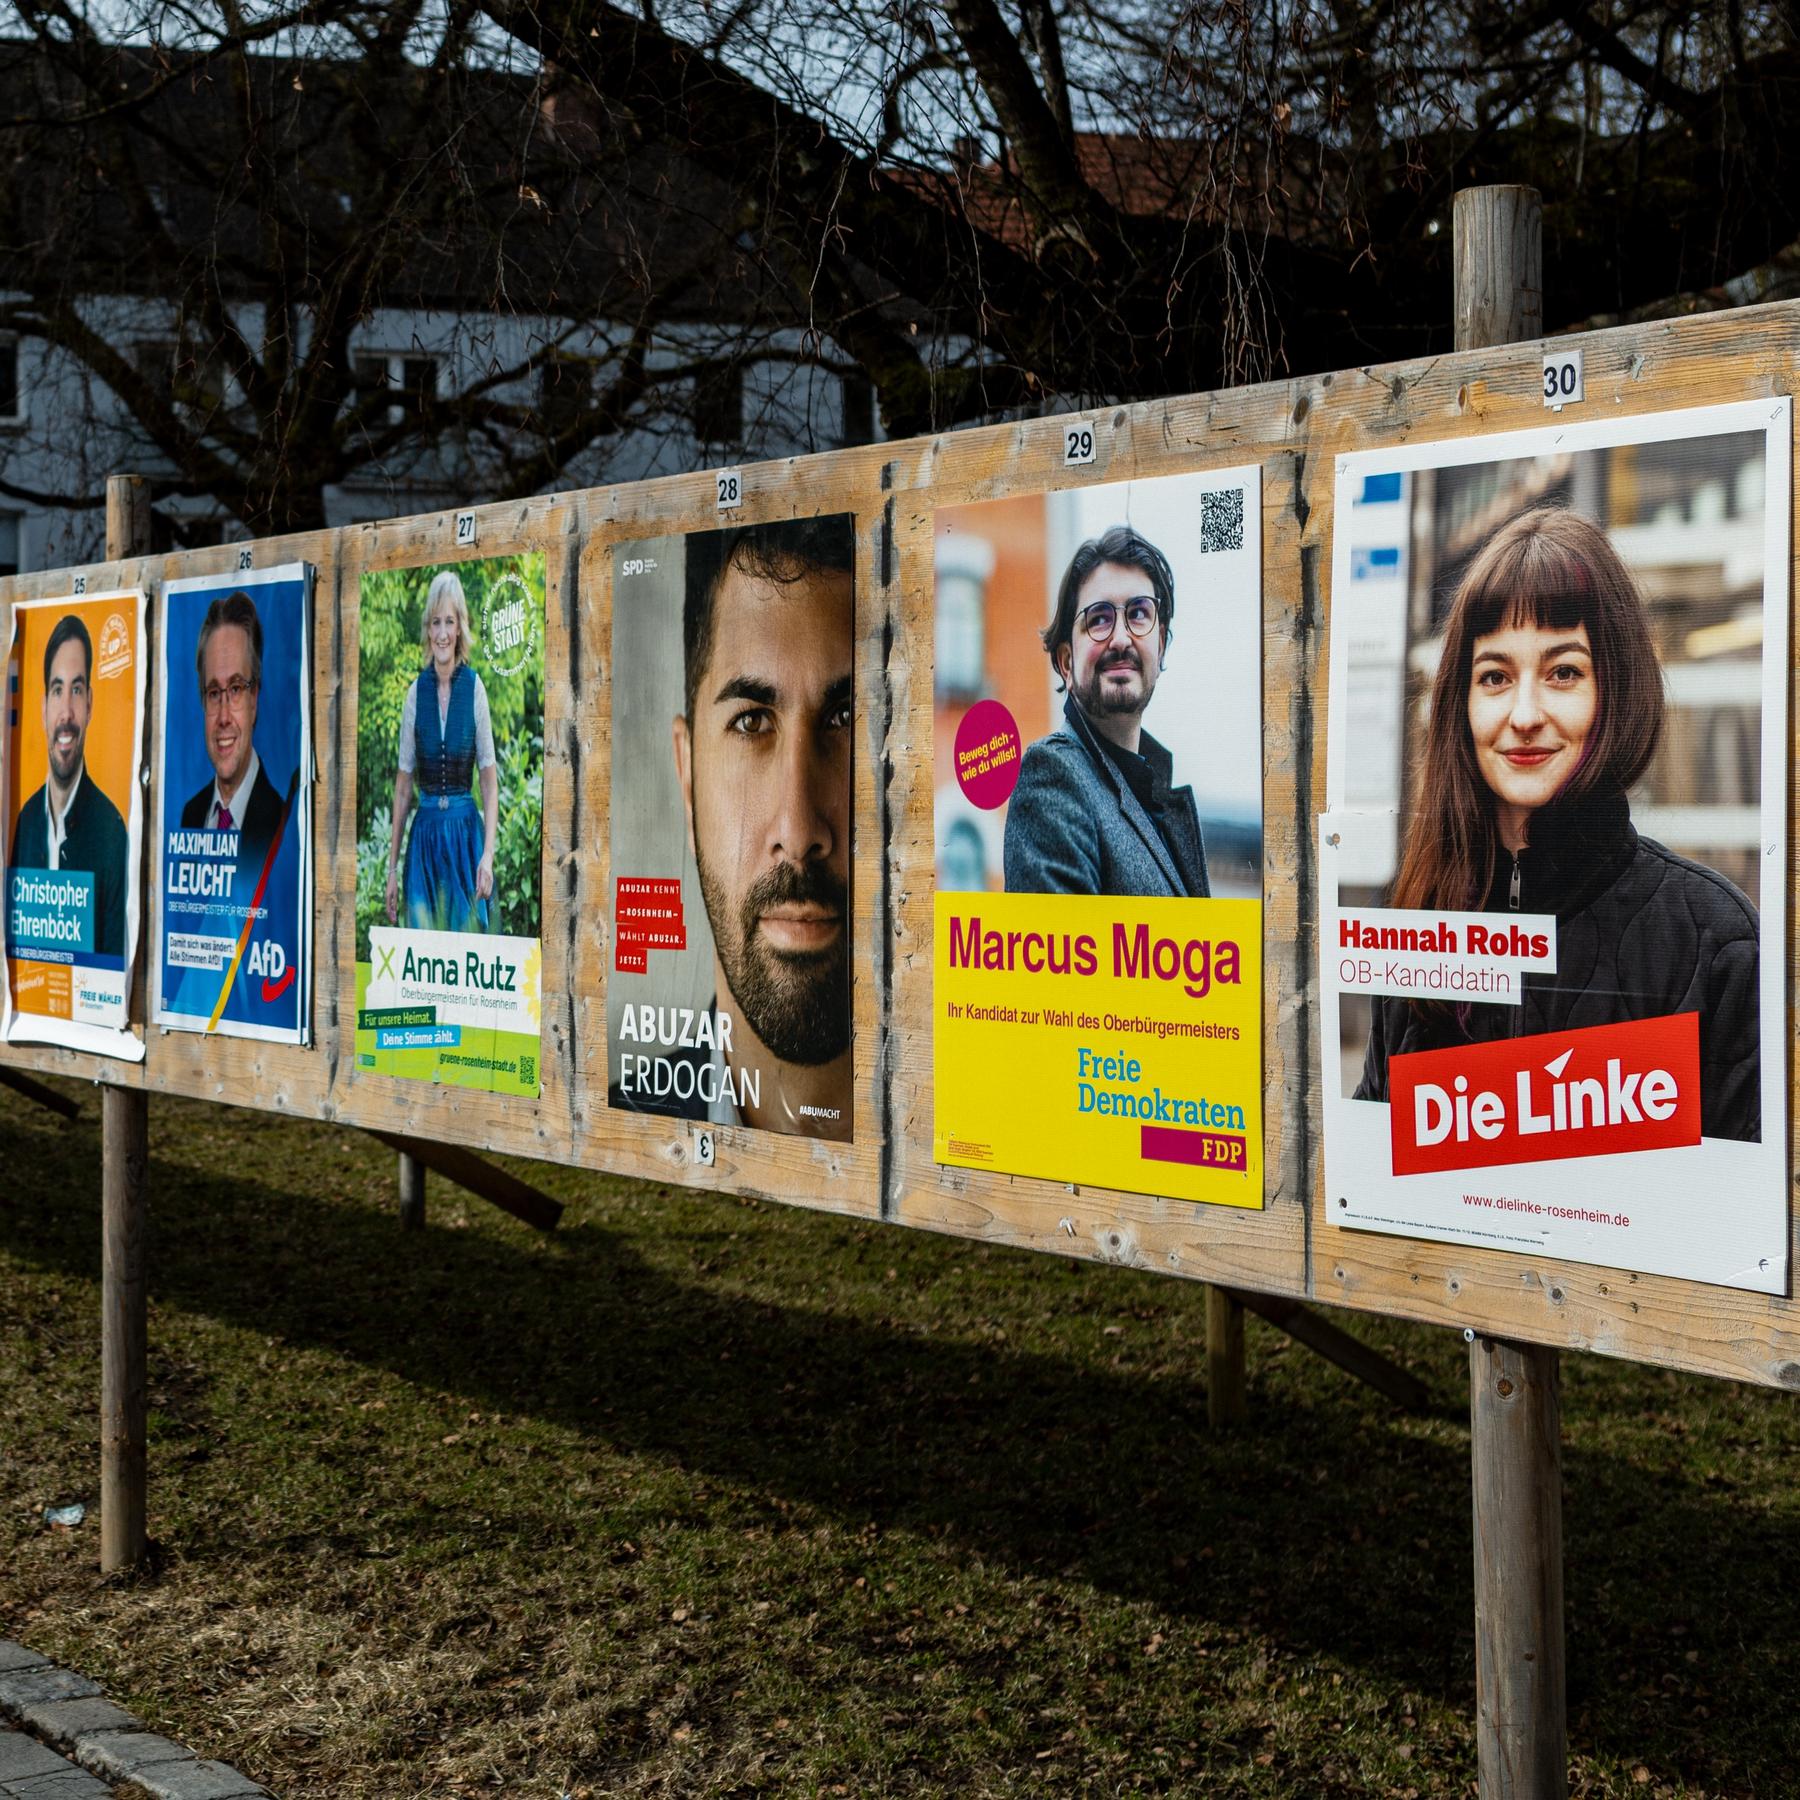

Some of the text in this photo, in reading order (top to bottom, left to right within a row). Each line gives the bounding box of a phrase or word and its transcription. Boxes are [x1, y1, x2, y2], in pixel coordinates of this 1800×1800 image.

[1543, 363, 1576, 397] 30
[1067, 431, 1093, 459] 29
[718, 477, 738, 502] 28
[459, 516, 473, 538] 27
[239, 552, 252, 570] 26
[622, 559, 643, 577] SPD
[74, 578, 85, 594] 25
[492, 599, 526, 632] GRÜNE
[494, 621, 525, 654] STADT
[959, 743, 989, 765] Beweg
[989, 732, 1009, 751] dich
[961, 745, 1017, 782] wie du willst!
[168, 832, 238, 857] MAXIMILIAN
[12, 876, 89, 912] Christopher
[167, 862, 237, 897] LEUCHT
[620, 883, 679, 894] ABUZAR KENNT
[12, 909, 81, 942] Ehrenböck
[168, 900, 268, 919] OBERBÜRGERMEISTER FÜR ROSENHEIM
[169, 936, 186, 949] Damit
[187, 937, 200, 949] sich
[200, 940, 211, 951] was
[619, 931, 683, 944] WÄHLT ABUZAR.
[1339, 919, 1549, 959] Hannah Rohs
[169, 951, 221, 966] Alle Stimmen AfD!
[247, 940, 286, 978] AfD
[402, 946, 516, 992] Anna Rutz
[619, 955, 645, 966] JETZT.
[950, 916, 1242, 999] Marcus Moga
[1339, 958, 1510, 993] OB-Kandidatin
[80, 990, 122, 1004] FREIE WÄHLER
[401, 987, 518, 1010] Oberbürgermeisterin für Rosenheim
[365, 1011, 432, 1026] Für unsere Heimat.
[619, 1003, 734, 1053] ABUZAR
[948, 1001, 1240, 1041] Ihr Kandidat zur Wahl des Oberbürgermeisters
[383, 1032, 404, 1046] Deine
[405, 1031, 433, 1044] Stimme
[620, 1053, 761, 1109] ERDOGAN
[1078, 1047, 1141, 1083] Freie
[800, 1105, 841, 1120] #ABUMACHT
[1078, 1083, 1246, 1130] Demokraten
[1414, 1048, 1679, 1147] Die Linke
[1202, 1138, 1242, 1164] FDP
[1462, 1194, 1630, 1227] www.dielinke-rosenheim.de
